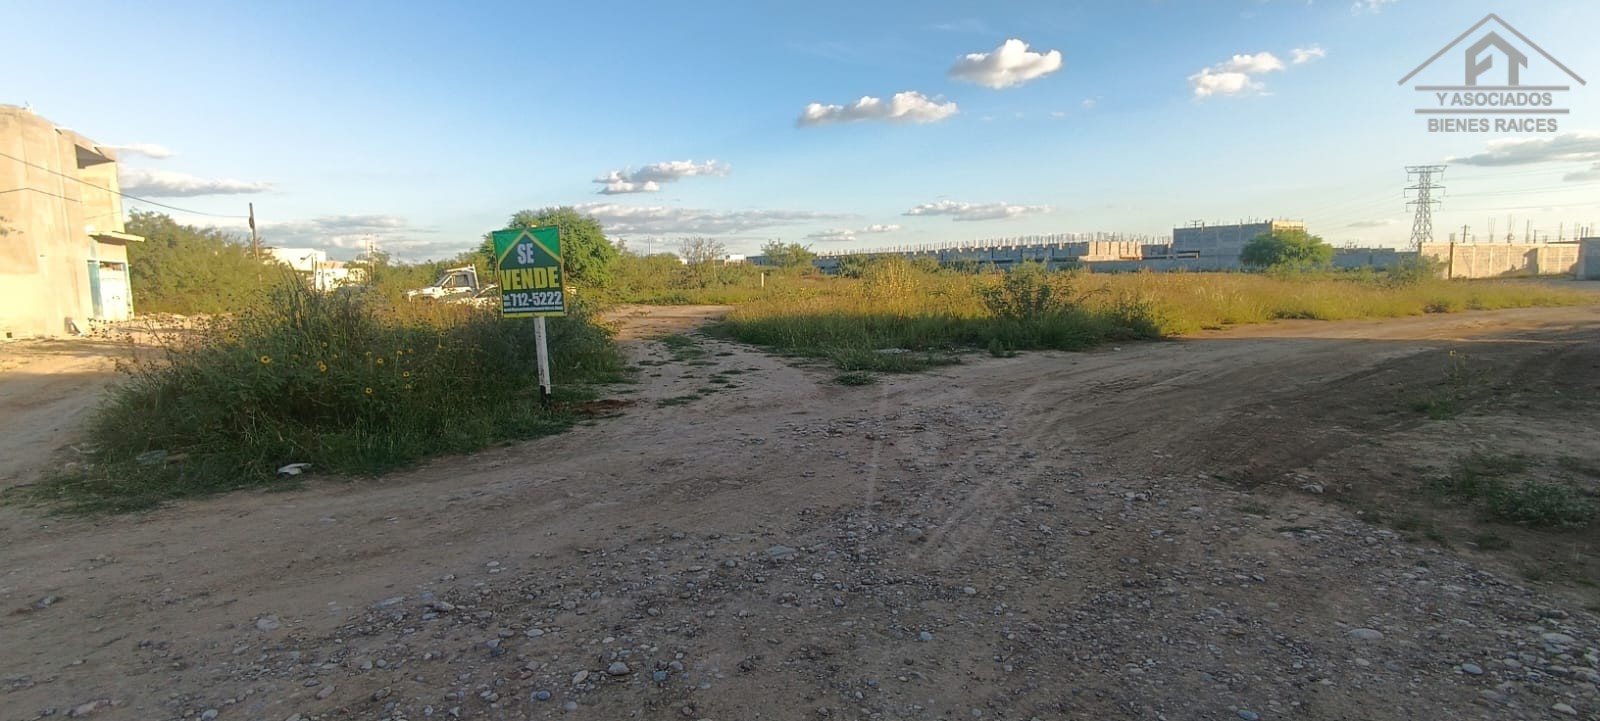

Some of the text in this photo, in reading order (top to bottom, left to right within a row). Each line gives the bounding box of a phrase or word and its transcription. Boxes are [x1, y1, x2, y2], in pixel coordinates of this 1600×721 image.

[517, 243, 535, 265] SE
[500, 266, 560, 290] VENDE
[510, 291, 563, 307] 712-5222
